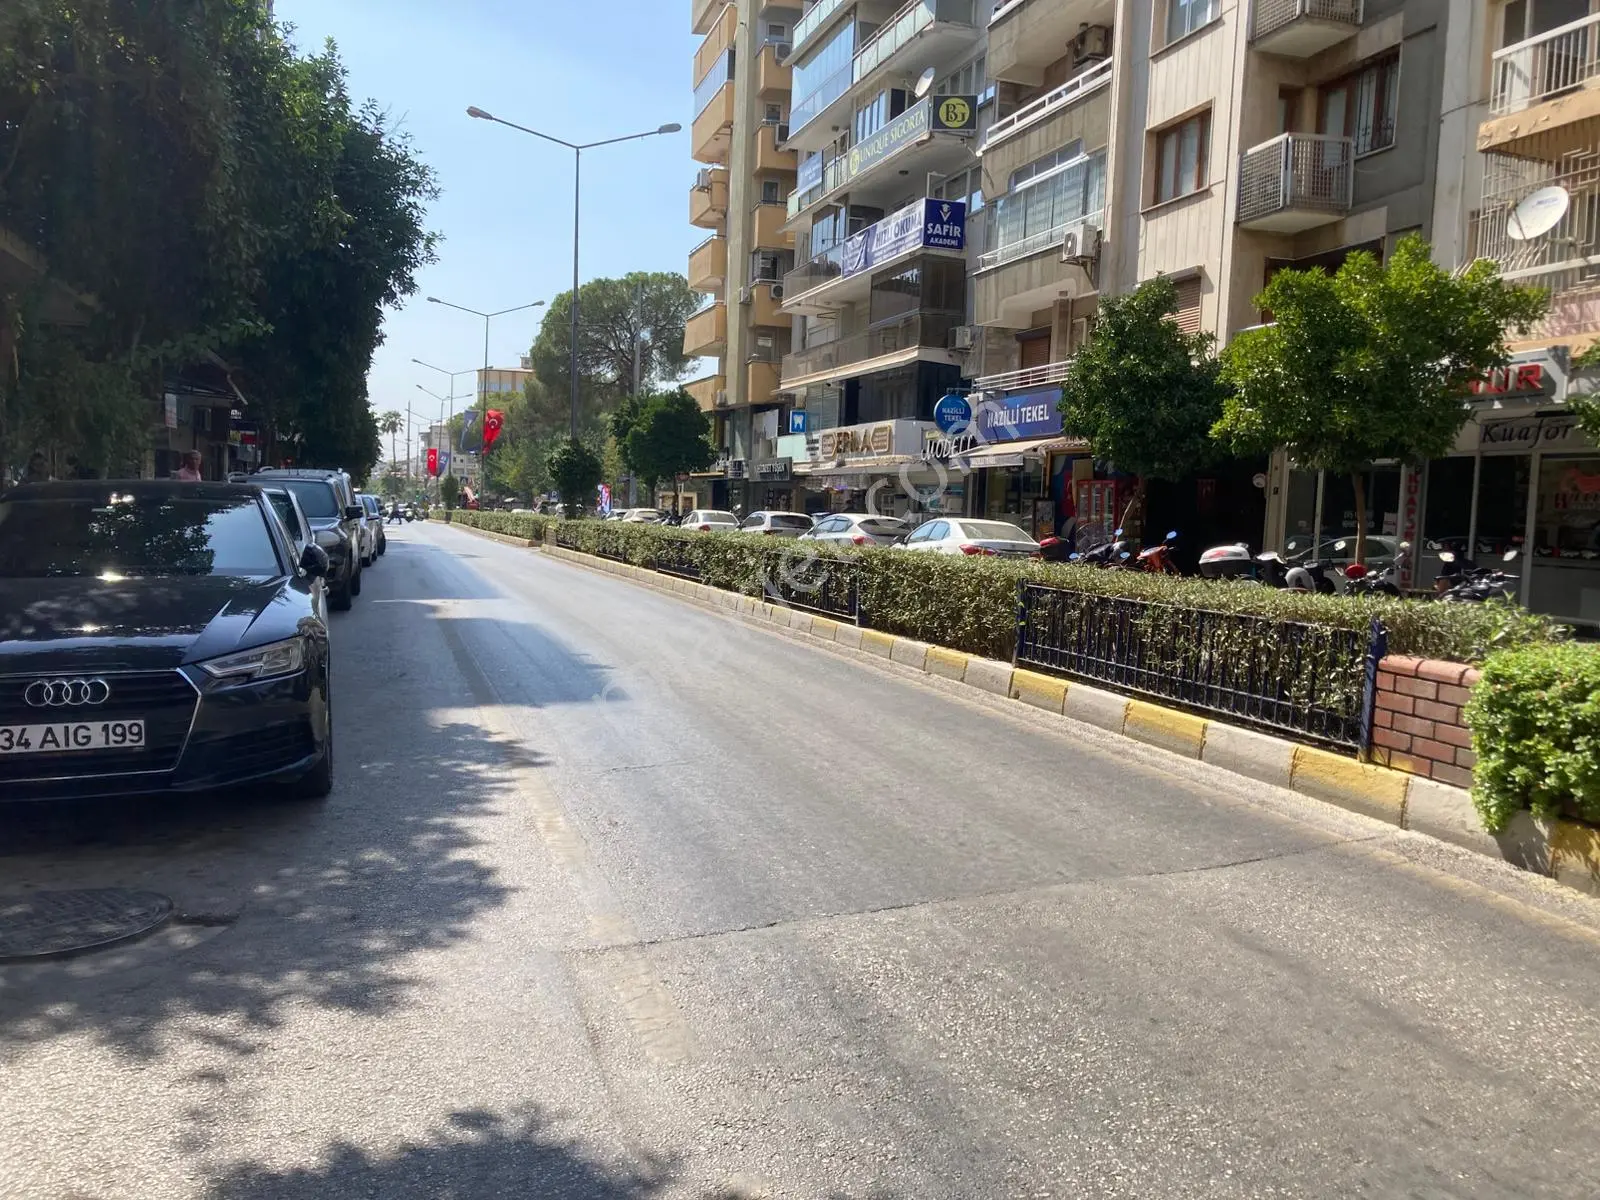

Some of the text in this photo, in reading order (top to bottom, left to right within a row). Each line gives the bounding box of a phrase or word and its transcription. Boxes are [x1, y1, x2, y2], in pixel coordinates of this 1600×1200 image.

[927, 222, 961, 238] SAFİR
[1021, 404, 1050, 423] TEKEL
[0, 722, 144, 751] 34 AIG 199
